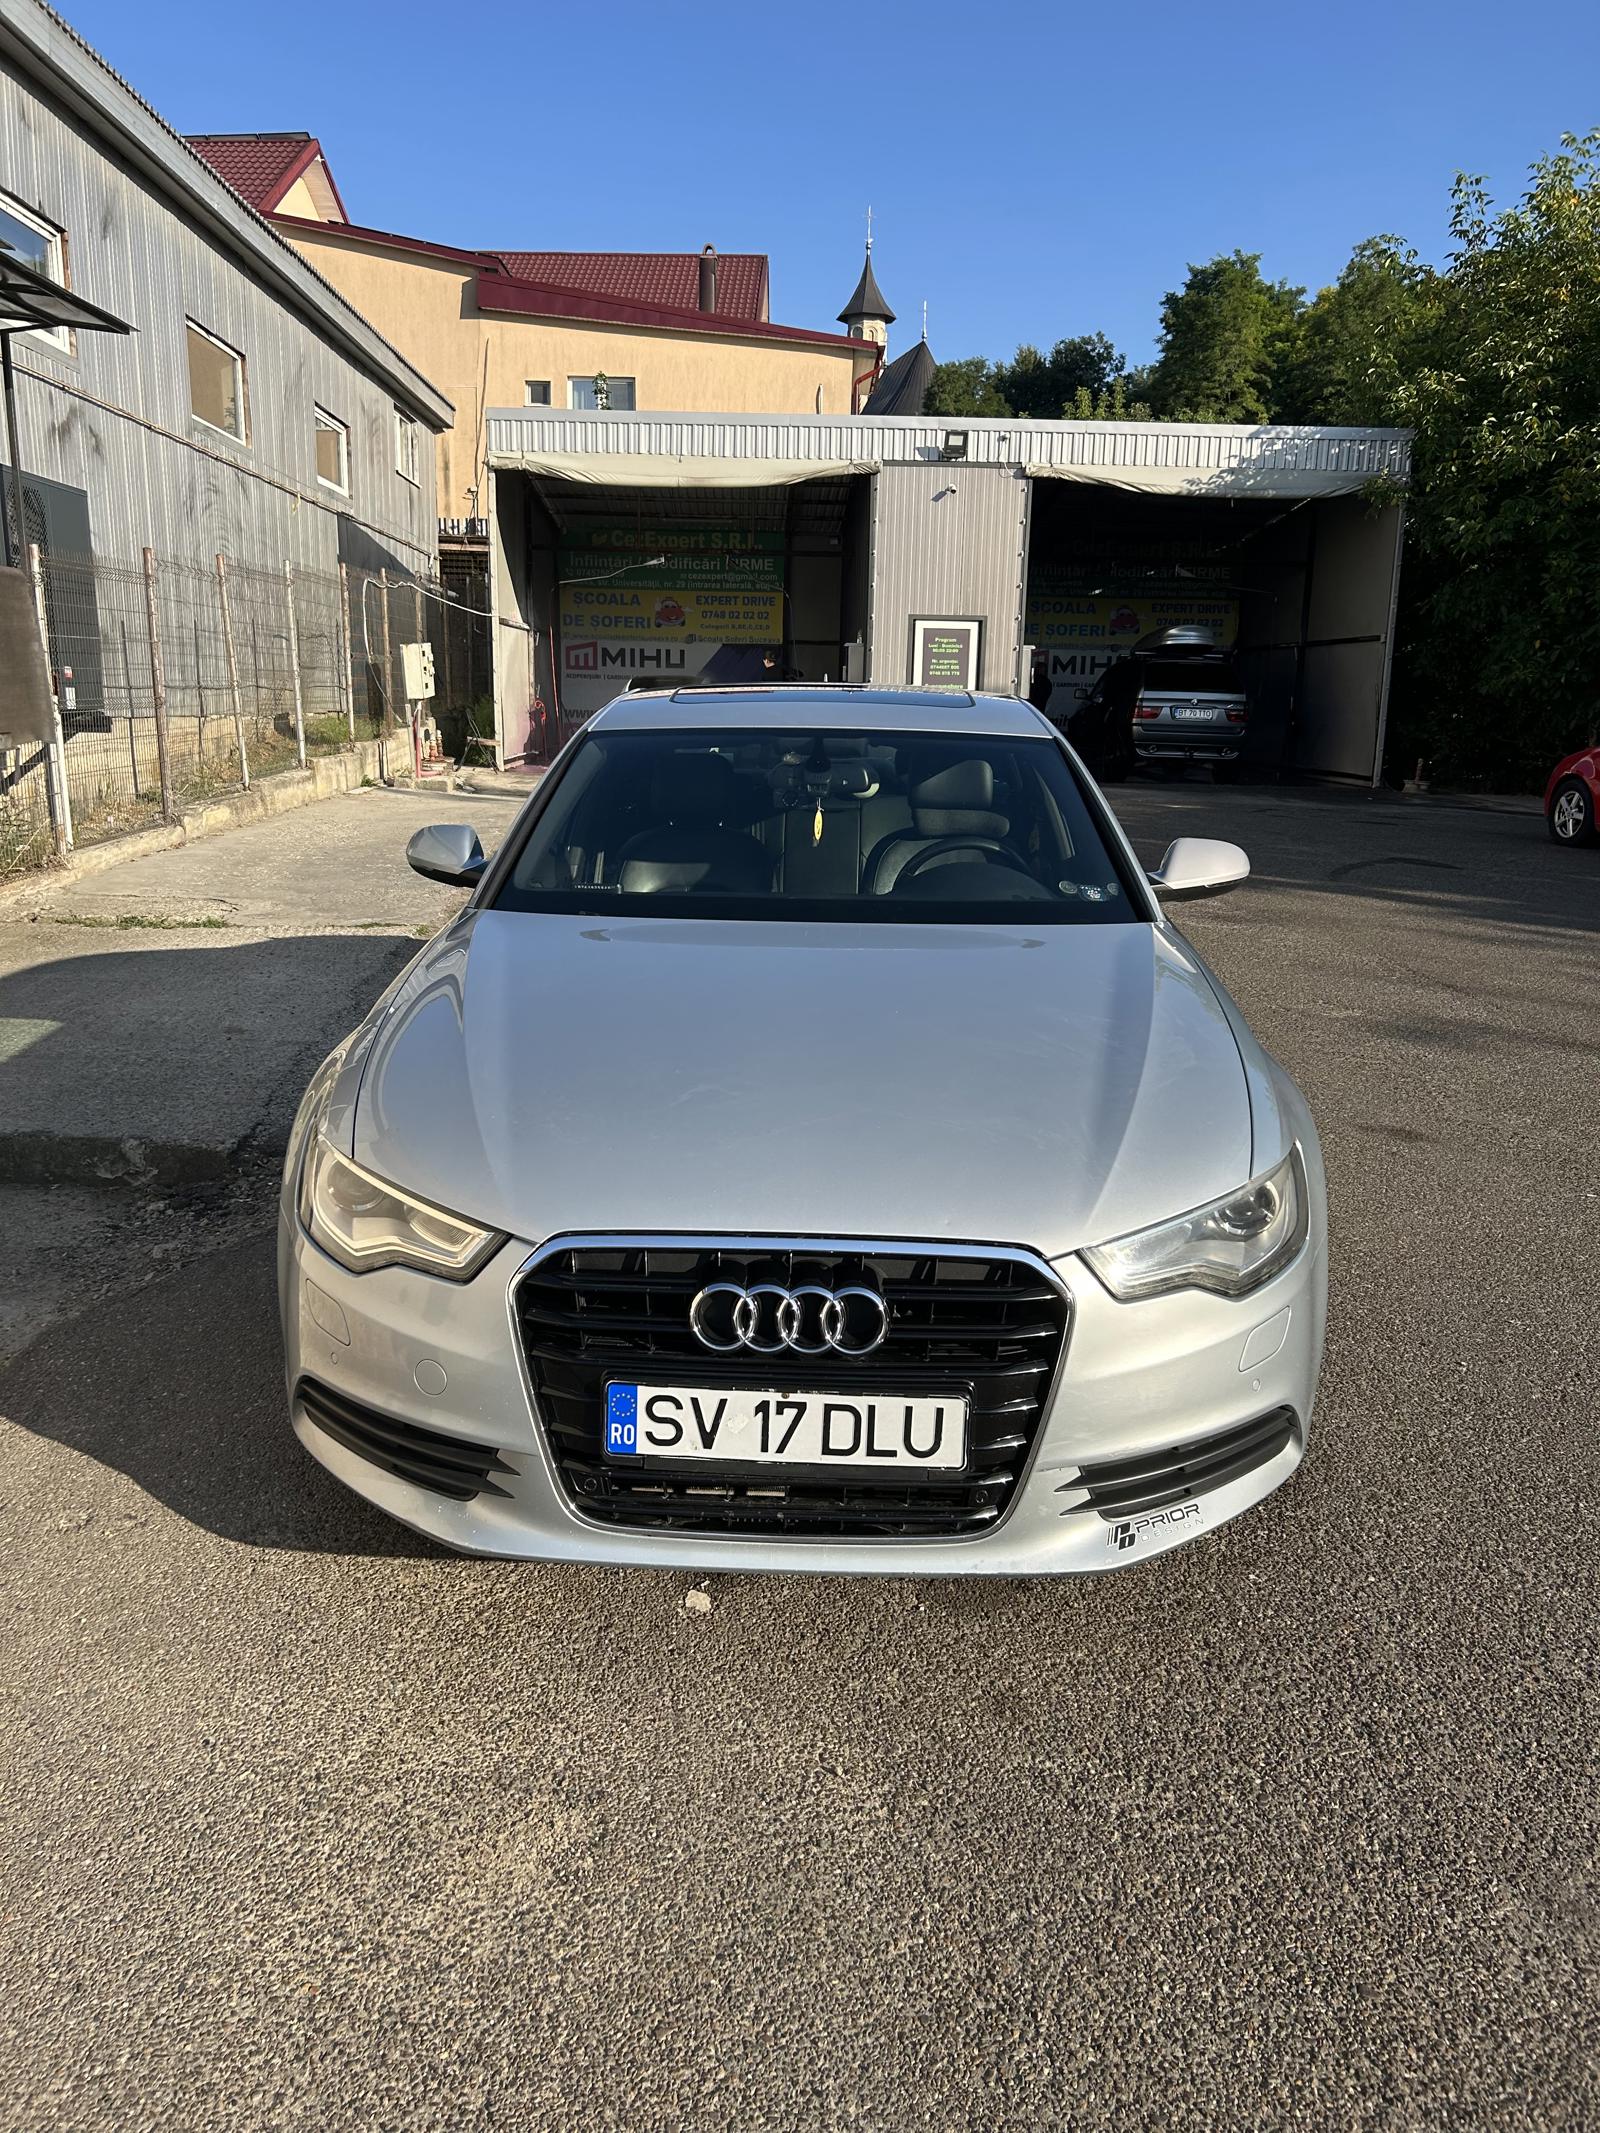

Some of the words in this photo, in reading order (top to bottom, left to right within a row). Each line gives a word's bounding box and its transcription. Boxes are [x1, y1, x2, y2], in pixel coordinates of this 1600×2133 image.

[696, 595, 739, 606] EXPERT
[743, 596, 776, 606] DRIVE
[1152, 603, 1195, 614] EXPERT
[1199, 604, 1232, 615] DRIVE
[563, 613, 584, 626] DE
[729, 610, 740, 619] 02
[743, 611, 755, 620] 02
[757, 611, 769, 620] 02
[602, 647, 685, 669] MIHU
[610, 1423, 634, 1445] RO
[645, 1394, 728, 1450] SV
[754, 1399, 807, 1454] 17
[821, 1402, 945, 1458] DLU
[1134, 1503, 1201, 1533] PRIOR
[1141, 1518, 1204, 1542] DESIGN
